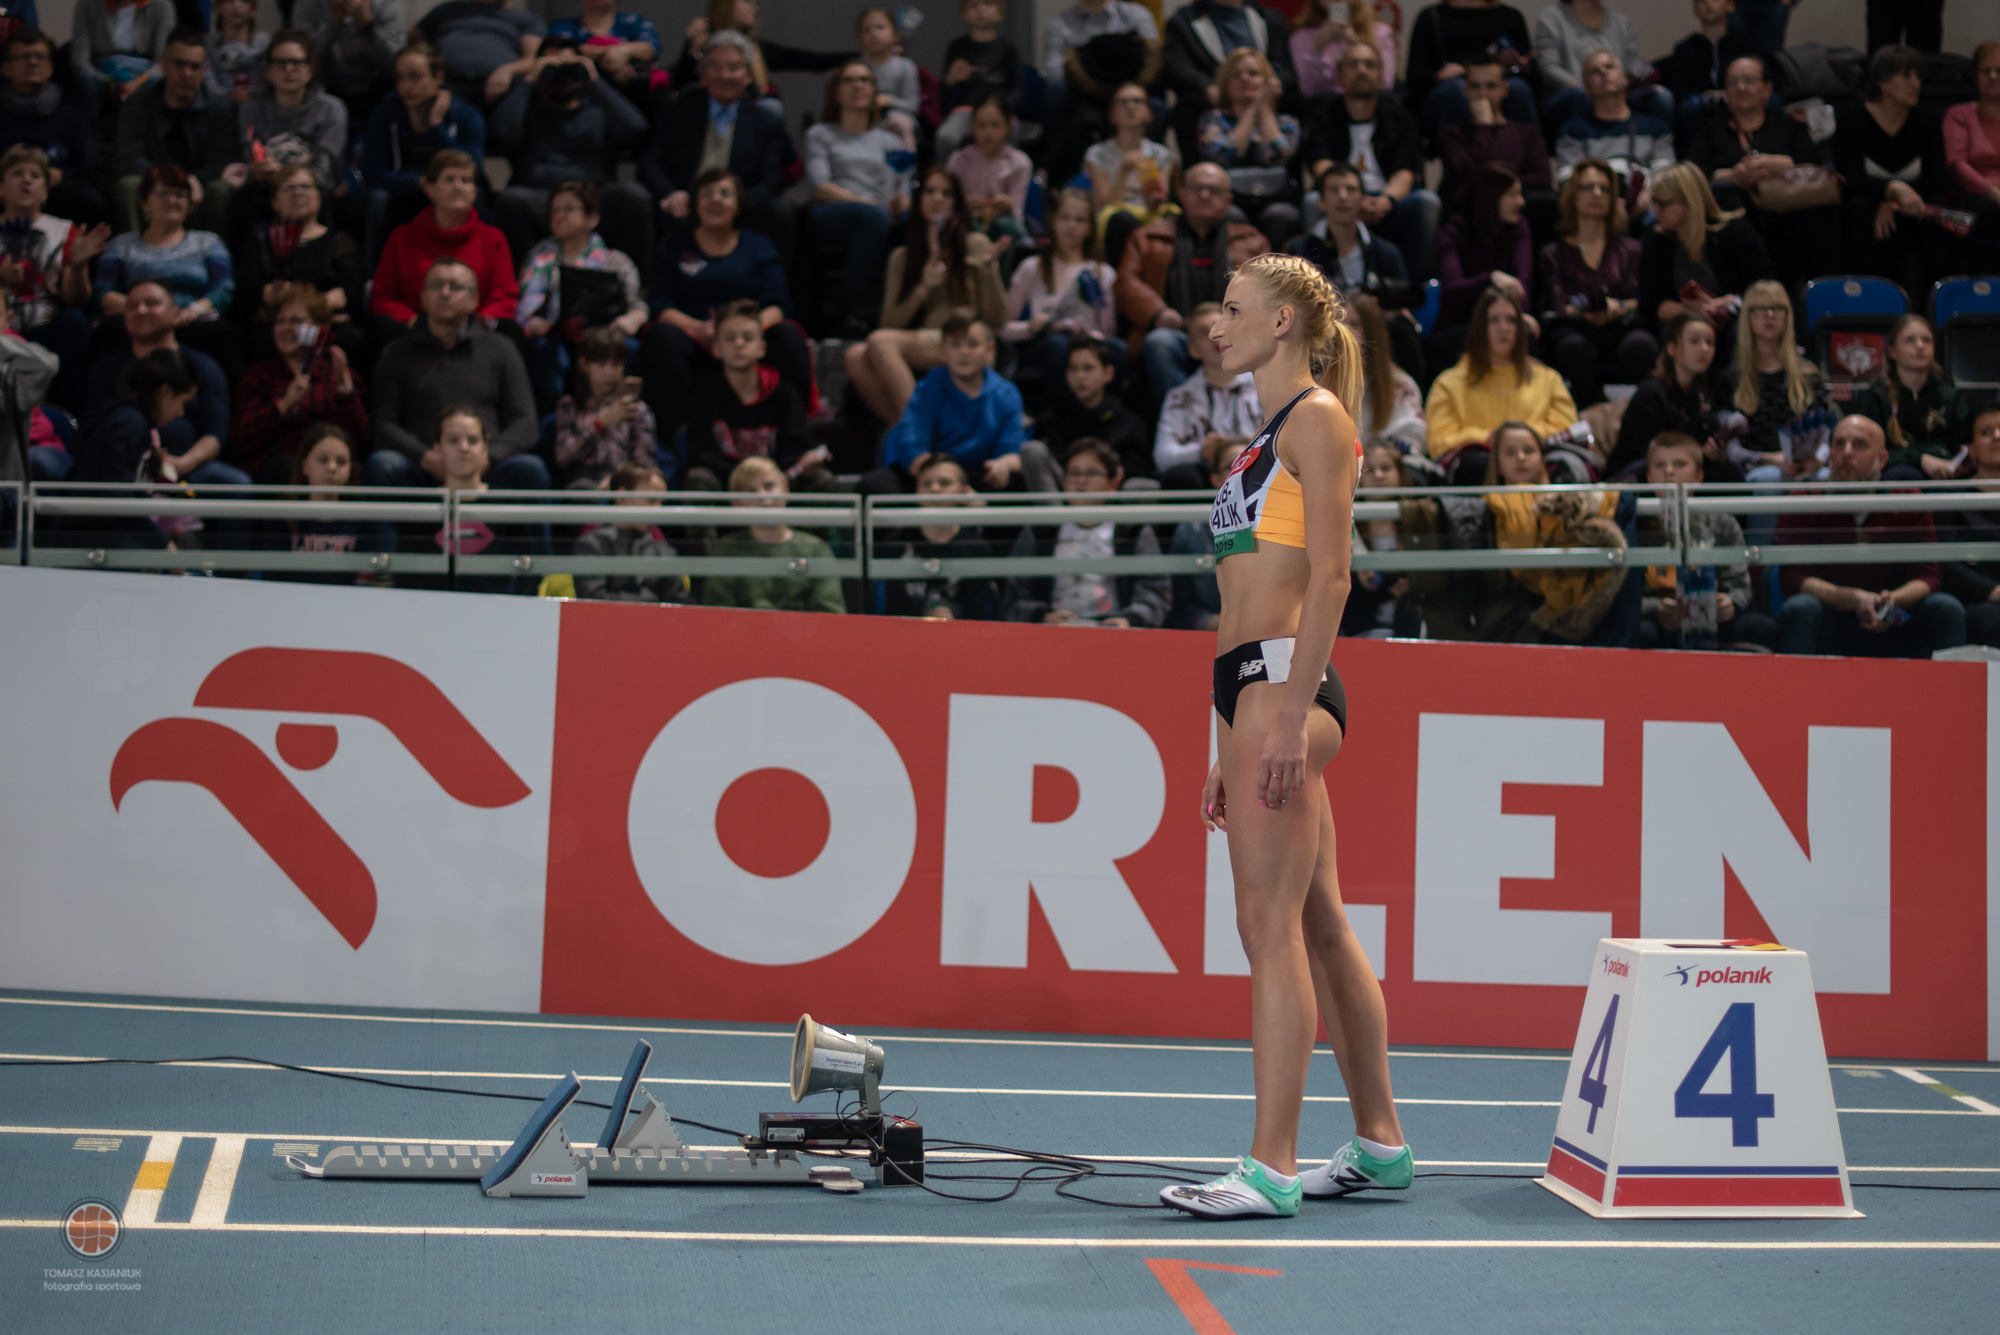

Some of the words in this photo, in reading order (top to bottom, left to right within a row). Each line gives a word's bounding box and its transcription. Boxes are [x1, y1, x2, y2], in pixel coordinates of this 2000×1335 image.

[1214, 481, 1231, 506] UB-
[1211, 502, 1242, 529] ALIK
[1215, 539, 1234, 554] 2019
[1607, 958, 1630, 978] polanik
[1696, 966, 1774, 987] polanik
[1578, 993, 1620, 1135] 4
[1674, 1002, 1775, 1147] 4
[544, 1175, 573, 1183] polanik
